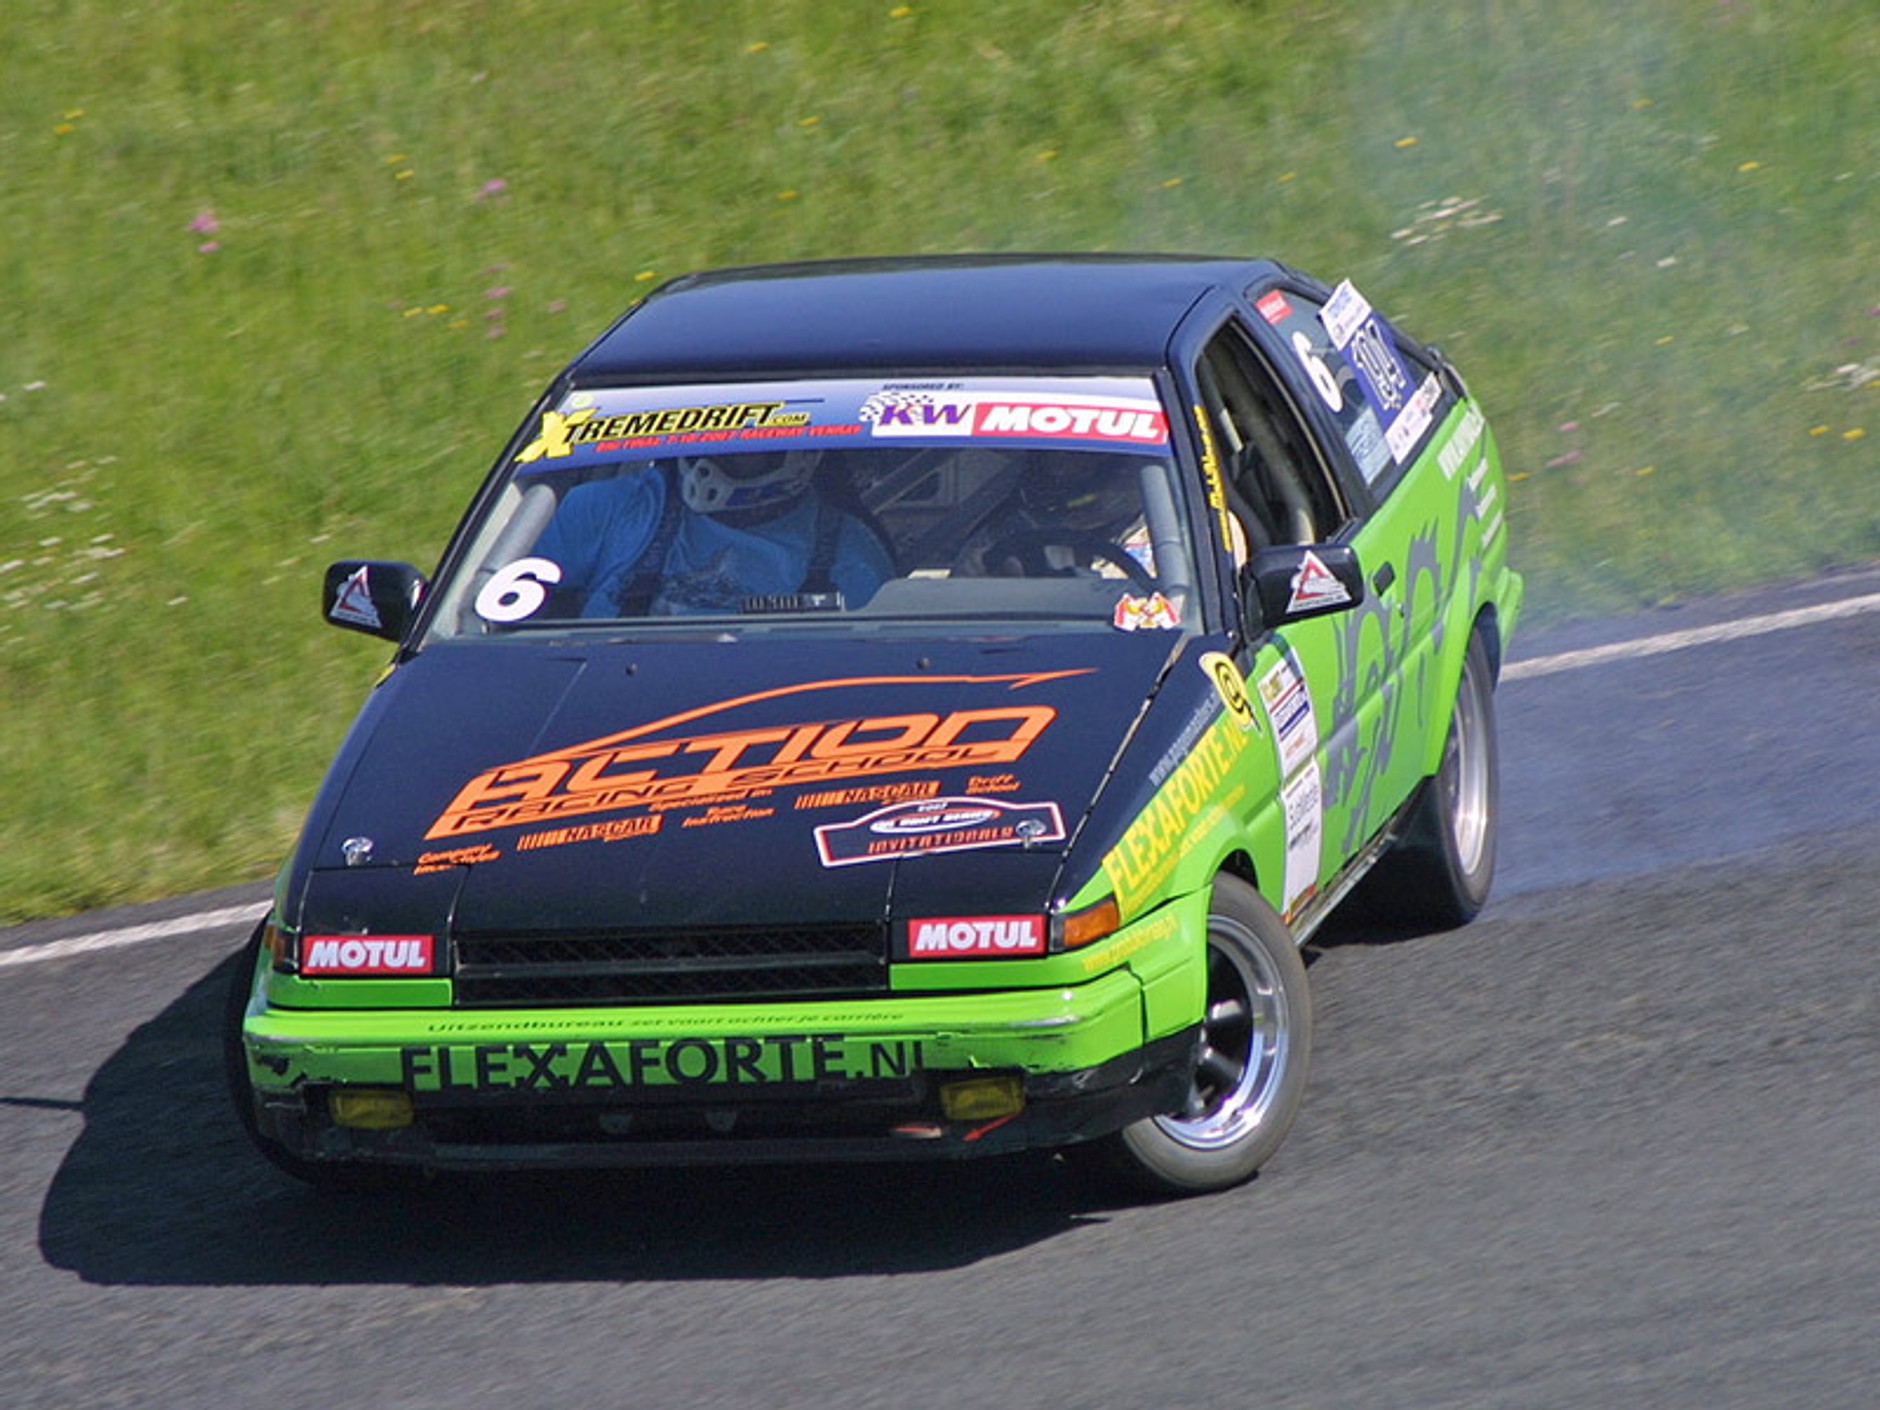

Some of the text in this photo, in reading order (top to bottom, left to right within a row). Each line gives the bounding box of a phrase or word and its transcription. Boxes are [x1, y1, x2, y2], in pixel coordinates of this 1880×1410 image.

[1292, 331, 1343, 413] 6
[879, 404, 1159, 439] KW MOTUL
[475, 557, 562, 623] 6
[915, 918, 1037, 950] MOTUL
[308, 940, 426, 968] MOTUL
